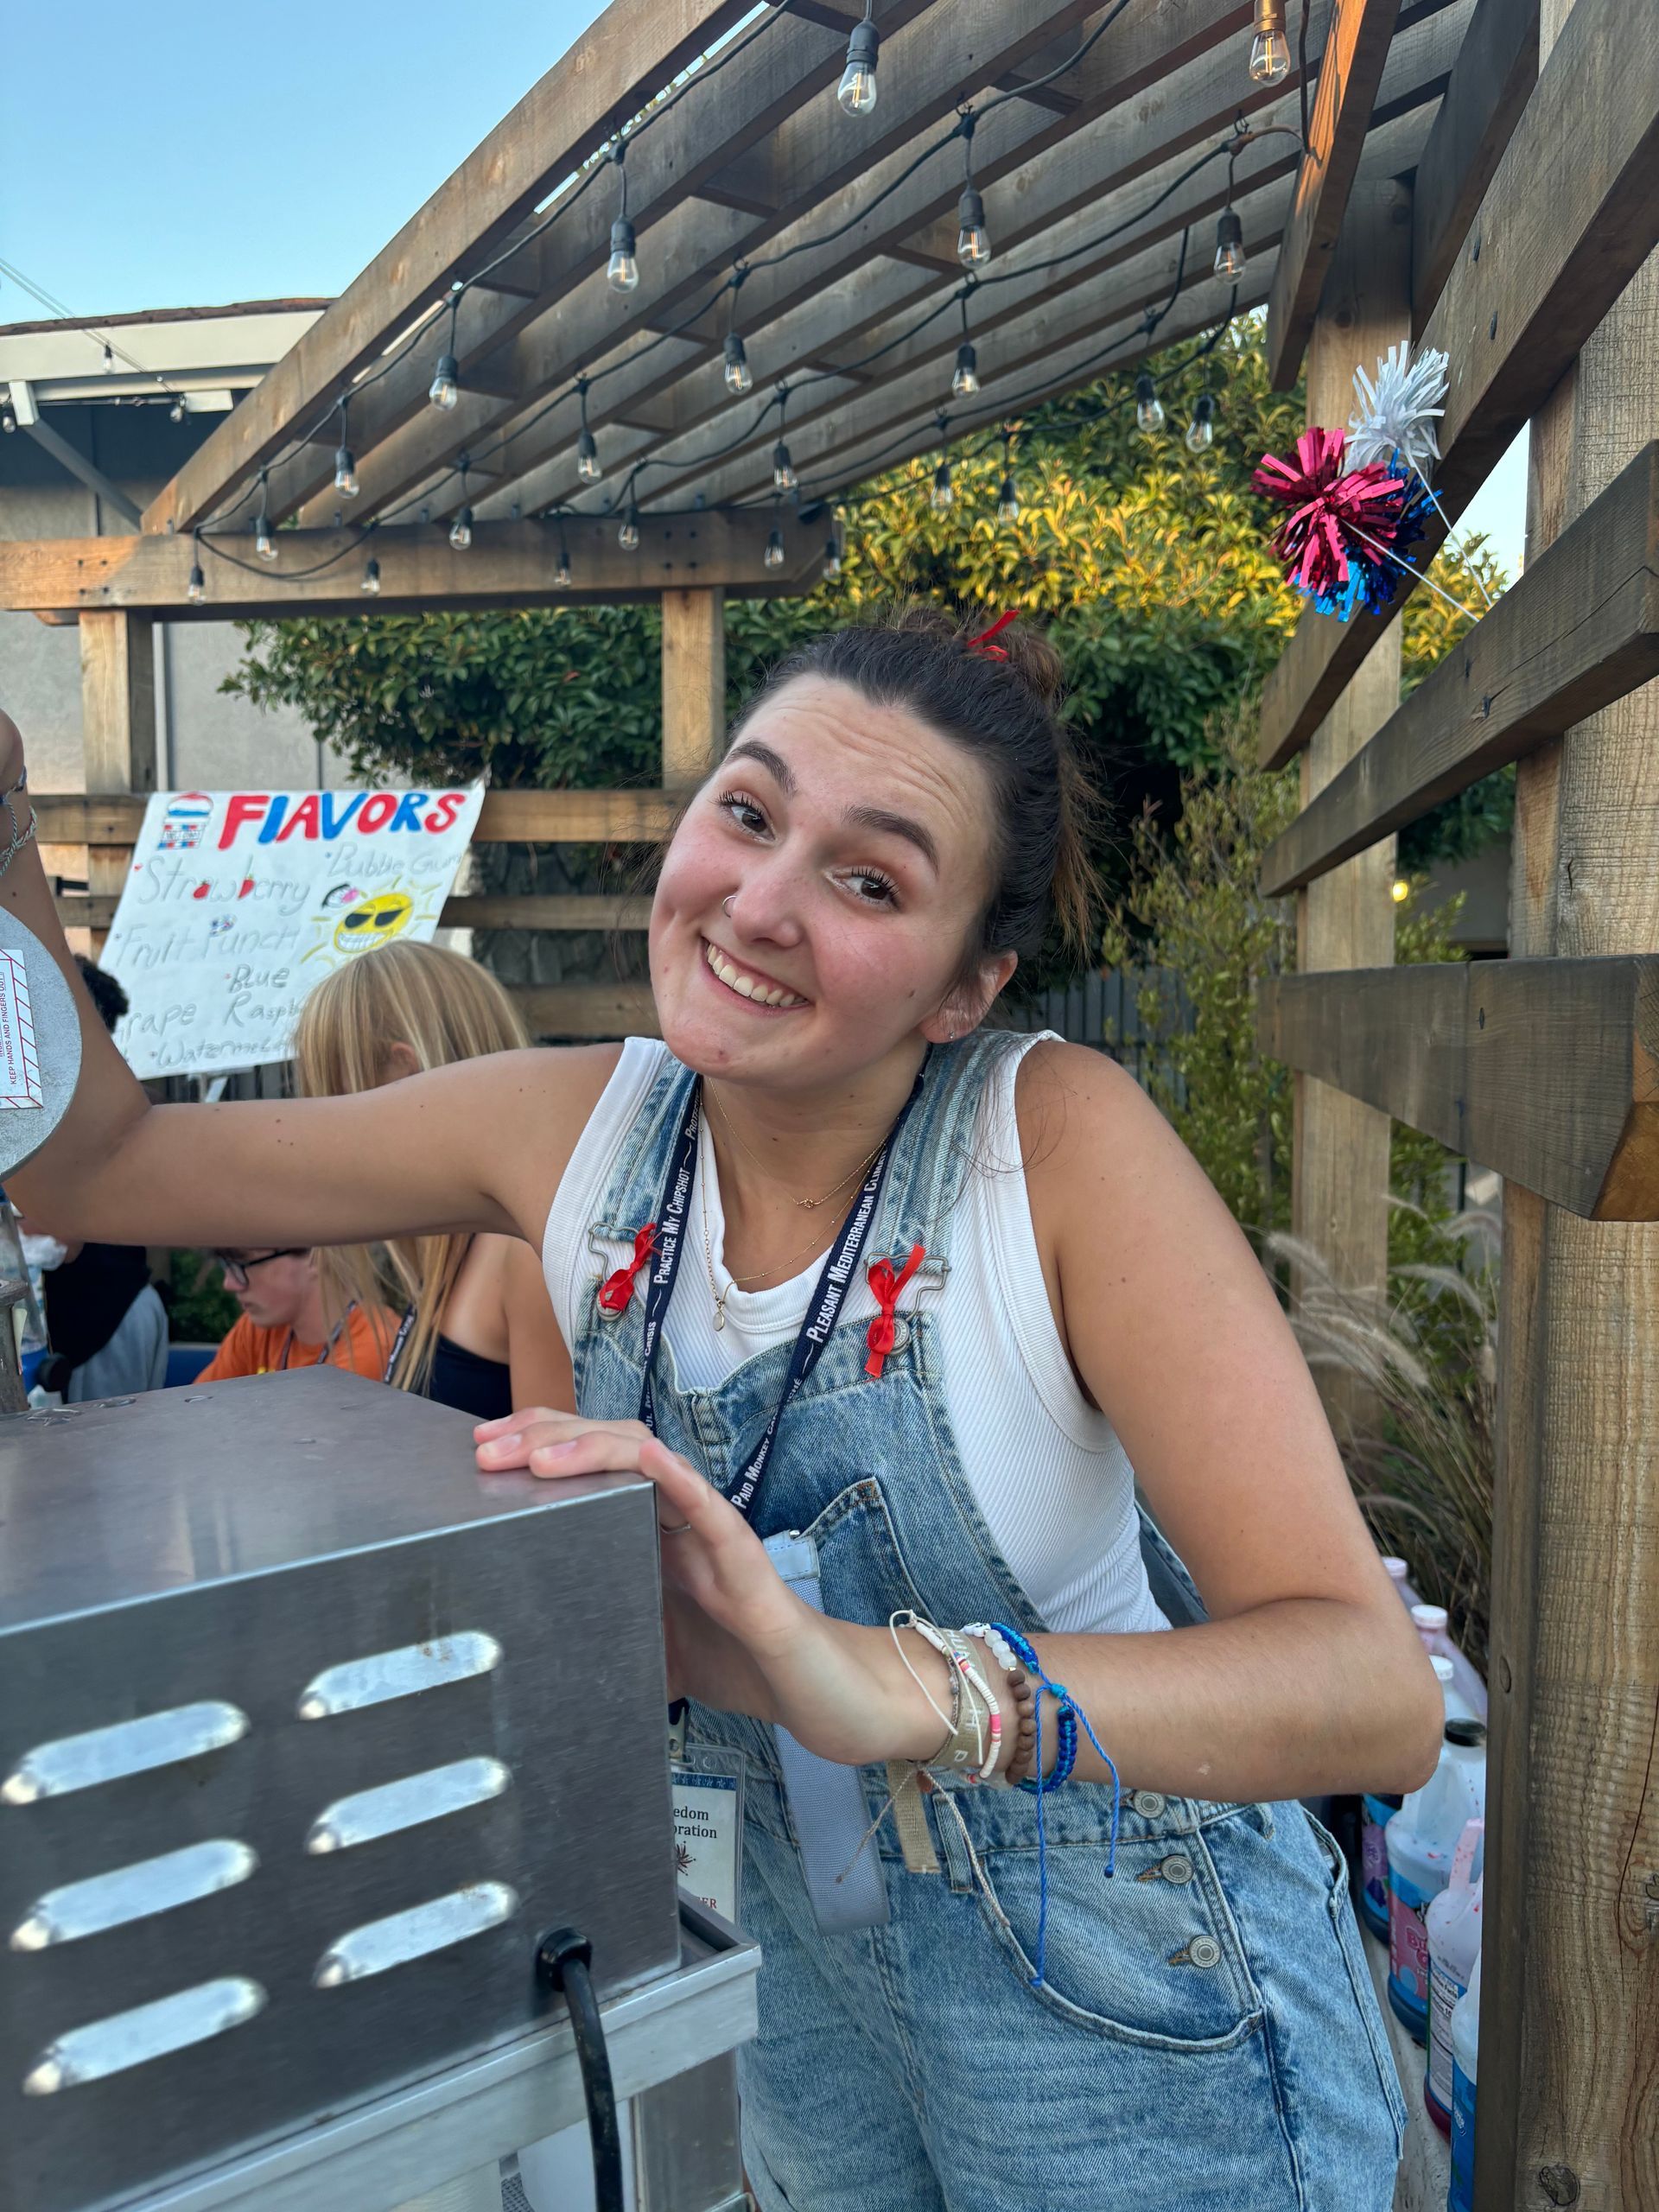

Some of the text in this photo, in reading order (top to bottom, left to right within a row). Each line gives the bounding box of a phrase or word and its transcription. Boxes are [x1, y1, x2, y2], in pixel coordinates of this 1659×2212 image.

[1, 993, 10, 1022] FINGERS
[223, 991, 302, 1027] Raspb
[6, 1040, 15, 1064] HANDS
[653, 1167, 690, 1284] PRACTICE MY CHIPSHOT
[806, 1284, 842, 1344] PLEASANT
[827, 1196, 874, 1283] MEDITERRANEAN
[645, 1321, 657, 1357] CRISIS
[731, 1482, 754, 1510] PAID
[744, 1438, 771, 1482] MONKEY
[673, 1806, 709, 1821] edom
